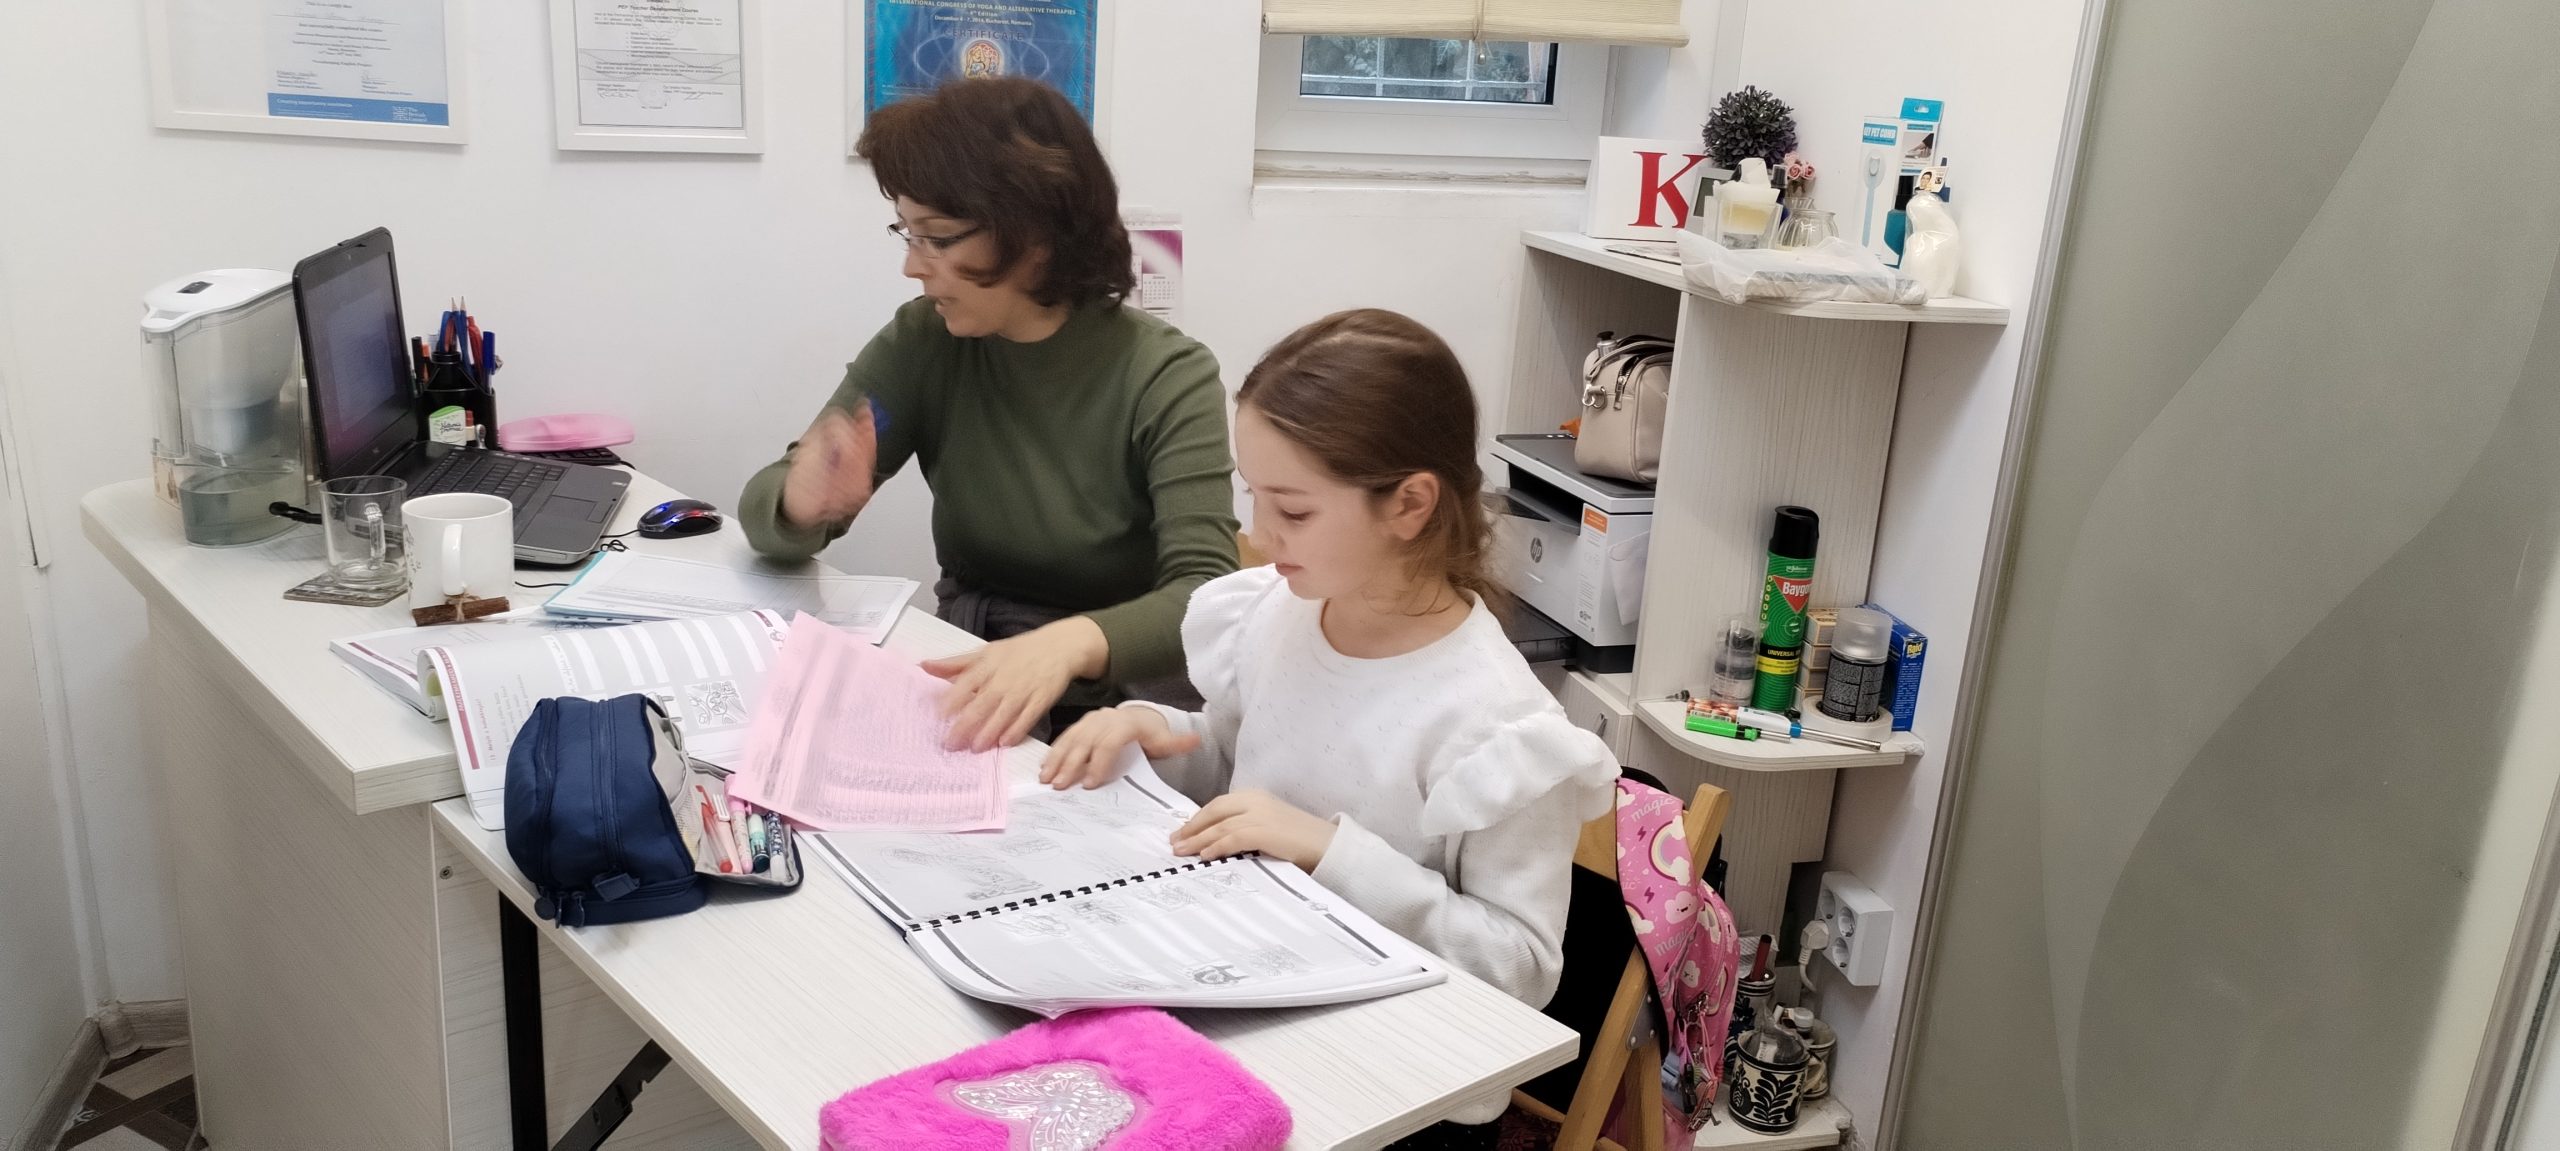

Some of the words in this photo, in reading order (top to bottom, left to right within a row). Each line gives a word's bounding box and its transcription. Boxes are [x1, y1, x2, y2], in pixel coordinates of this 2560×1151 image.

[936, 1, 967, 9] CONGRESS
[1008, 5, 1045, 14] ALTERNATIVE
[1046, 7, 1077, 16] THERAPIES
[944, 28, 1024, 41] CERTIFICATE
[1627, 151, 1711, 229] K
[1782, 581, 1811, 597] Baygo
[1767, 649, 1795, 657] UNIVERSAL
[1631, 796, 1675, 822] magic
